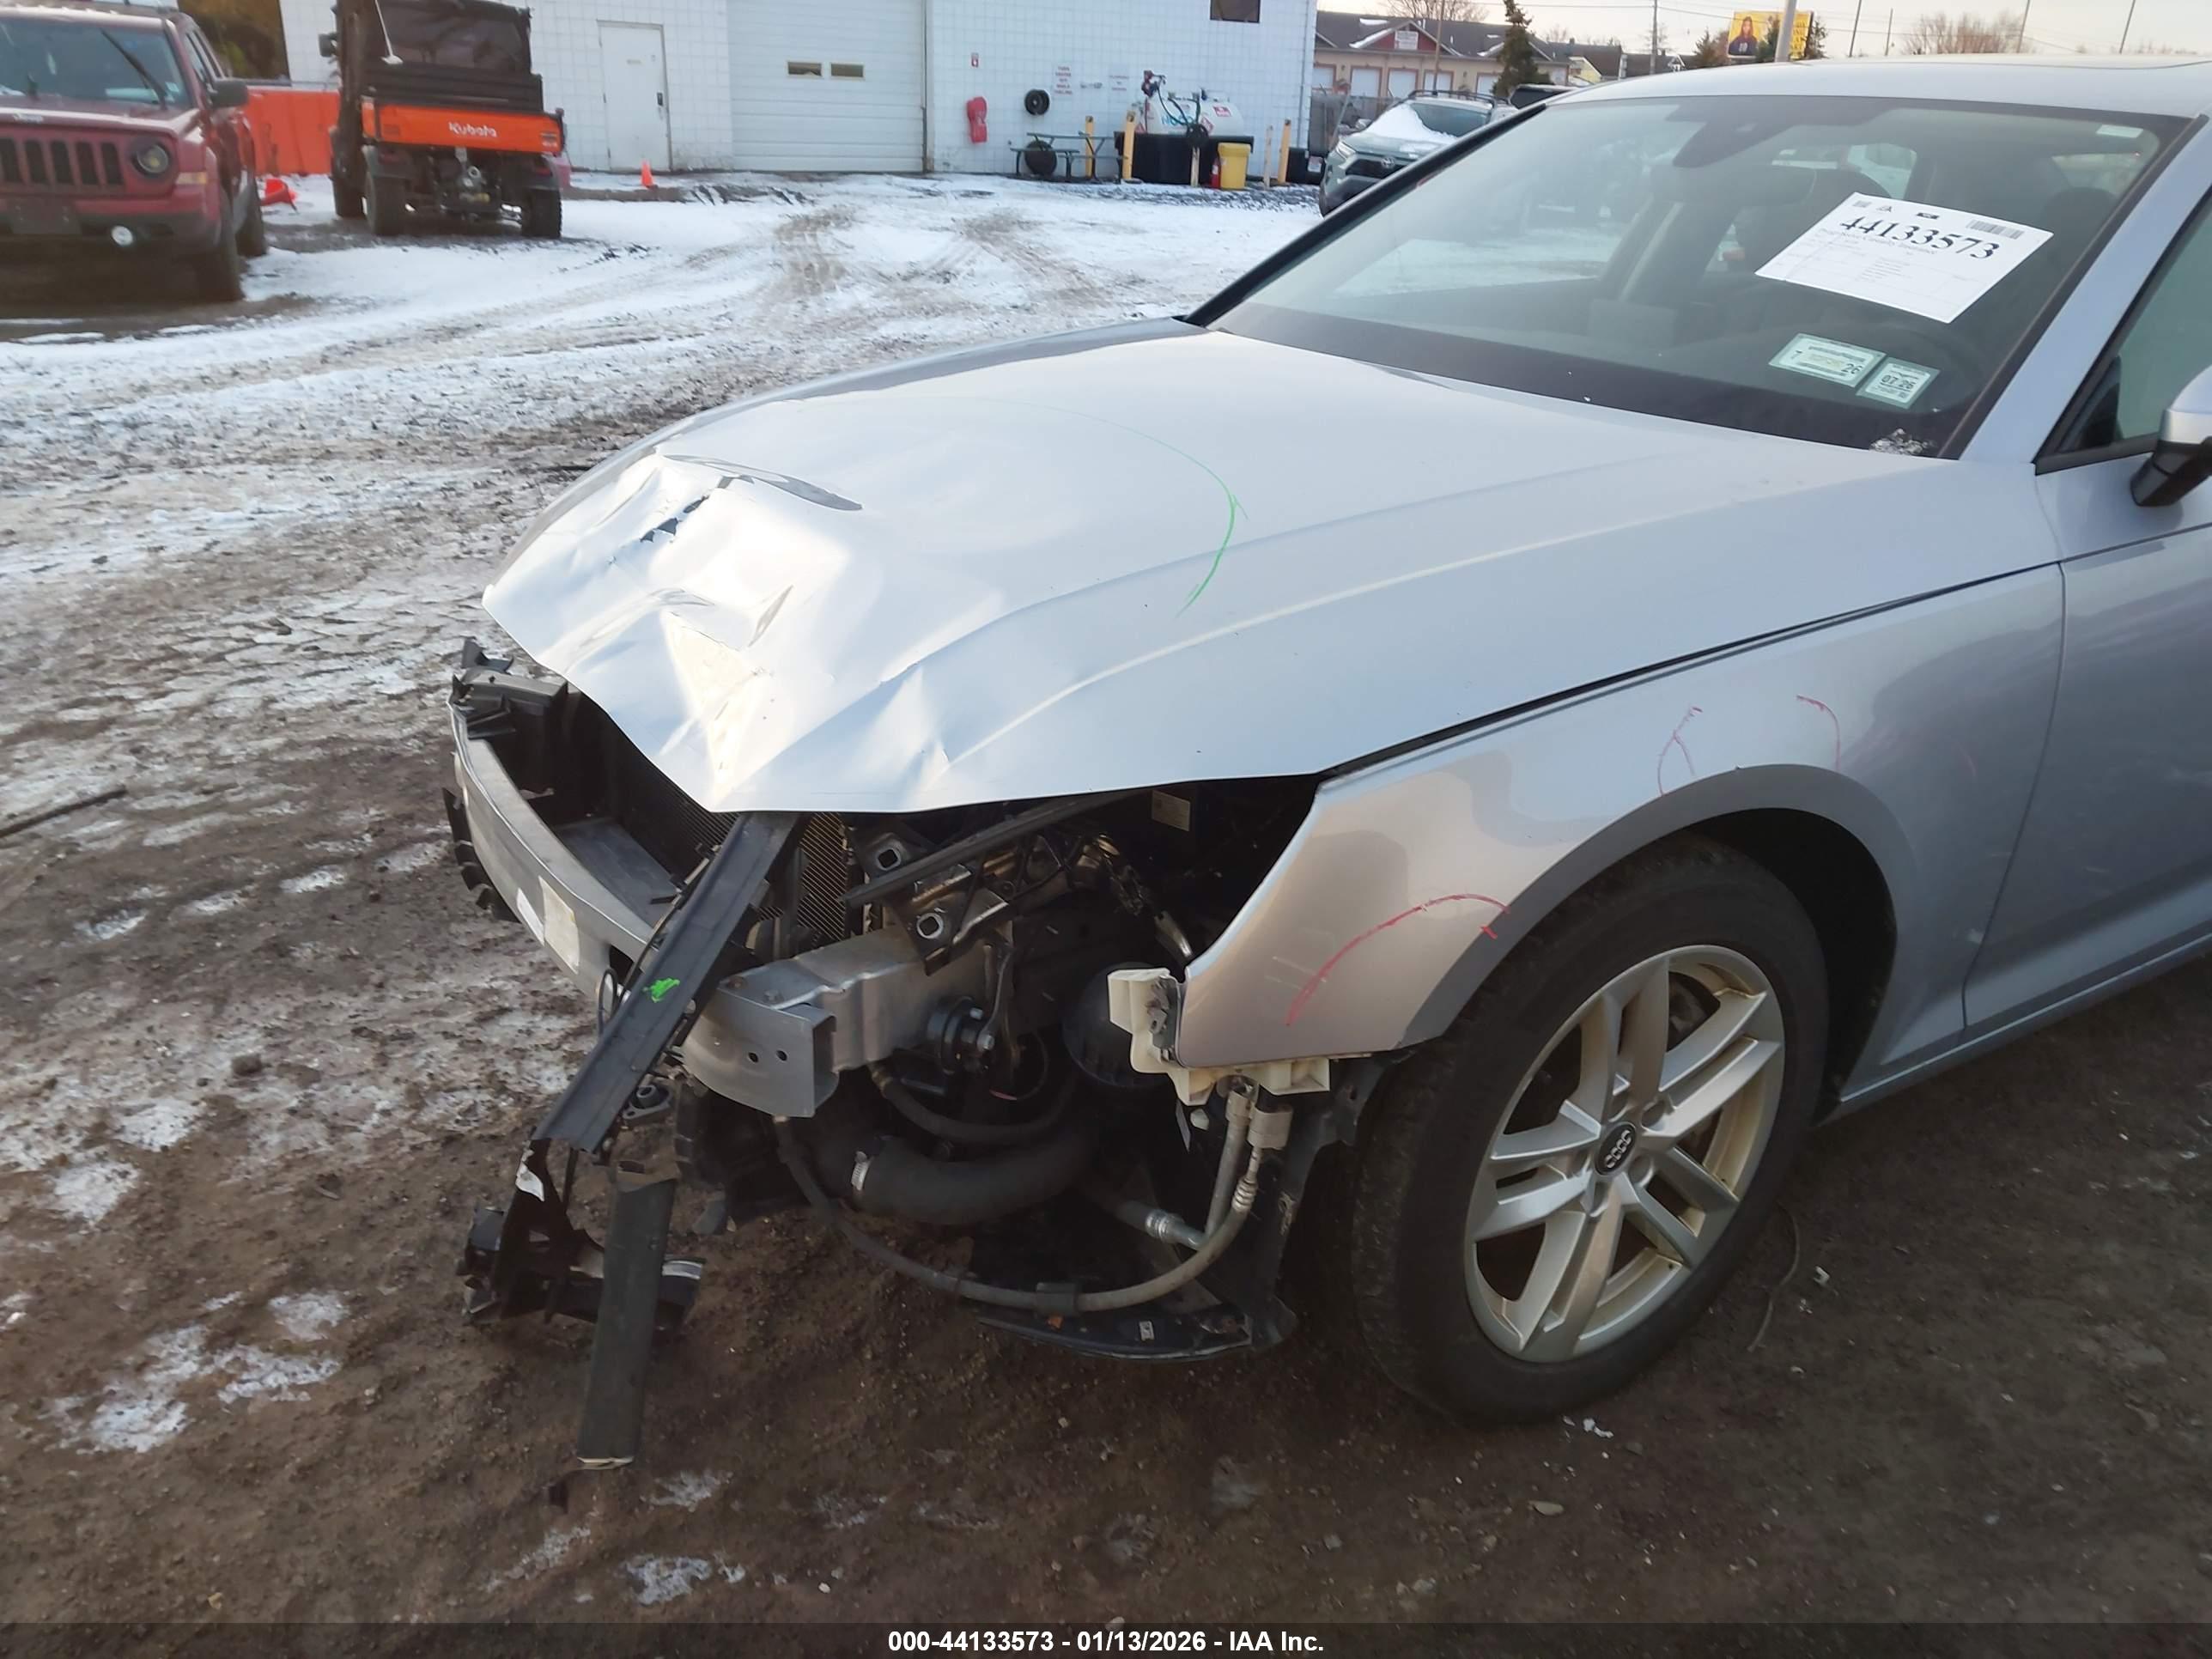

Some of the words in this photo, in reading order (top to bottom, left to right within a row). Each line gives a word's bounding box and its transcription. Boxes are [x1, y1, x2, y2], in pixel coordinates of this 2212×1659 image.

[449, 121, 497, 137] Kubota
[1839, 216, 2000, 259] 44133573
[1841, 363, 1863, 374] 26
[1881, 375, 1898, 385] 07
